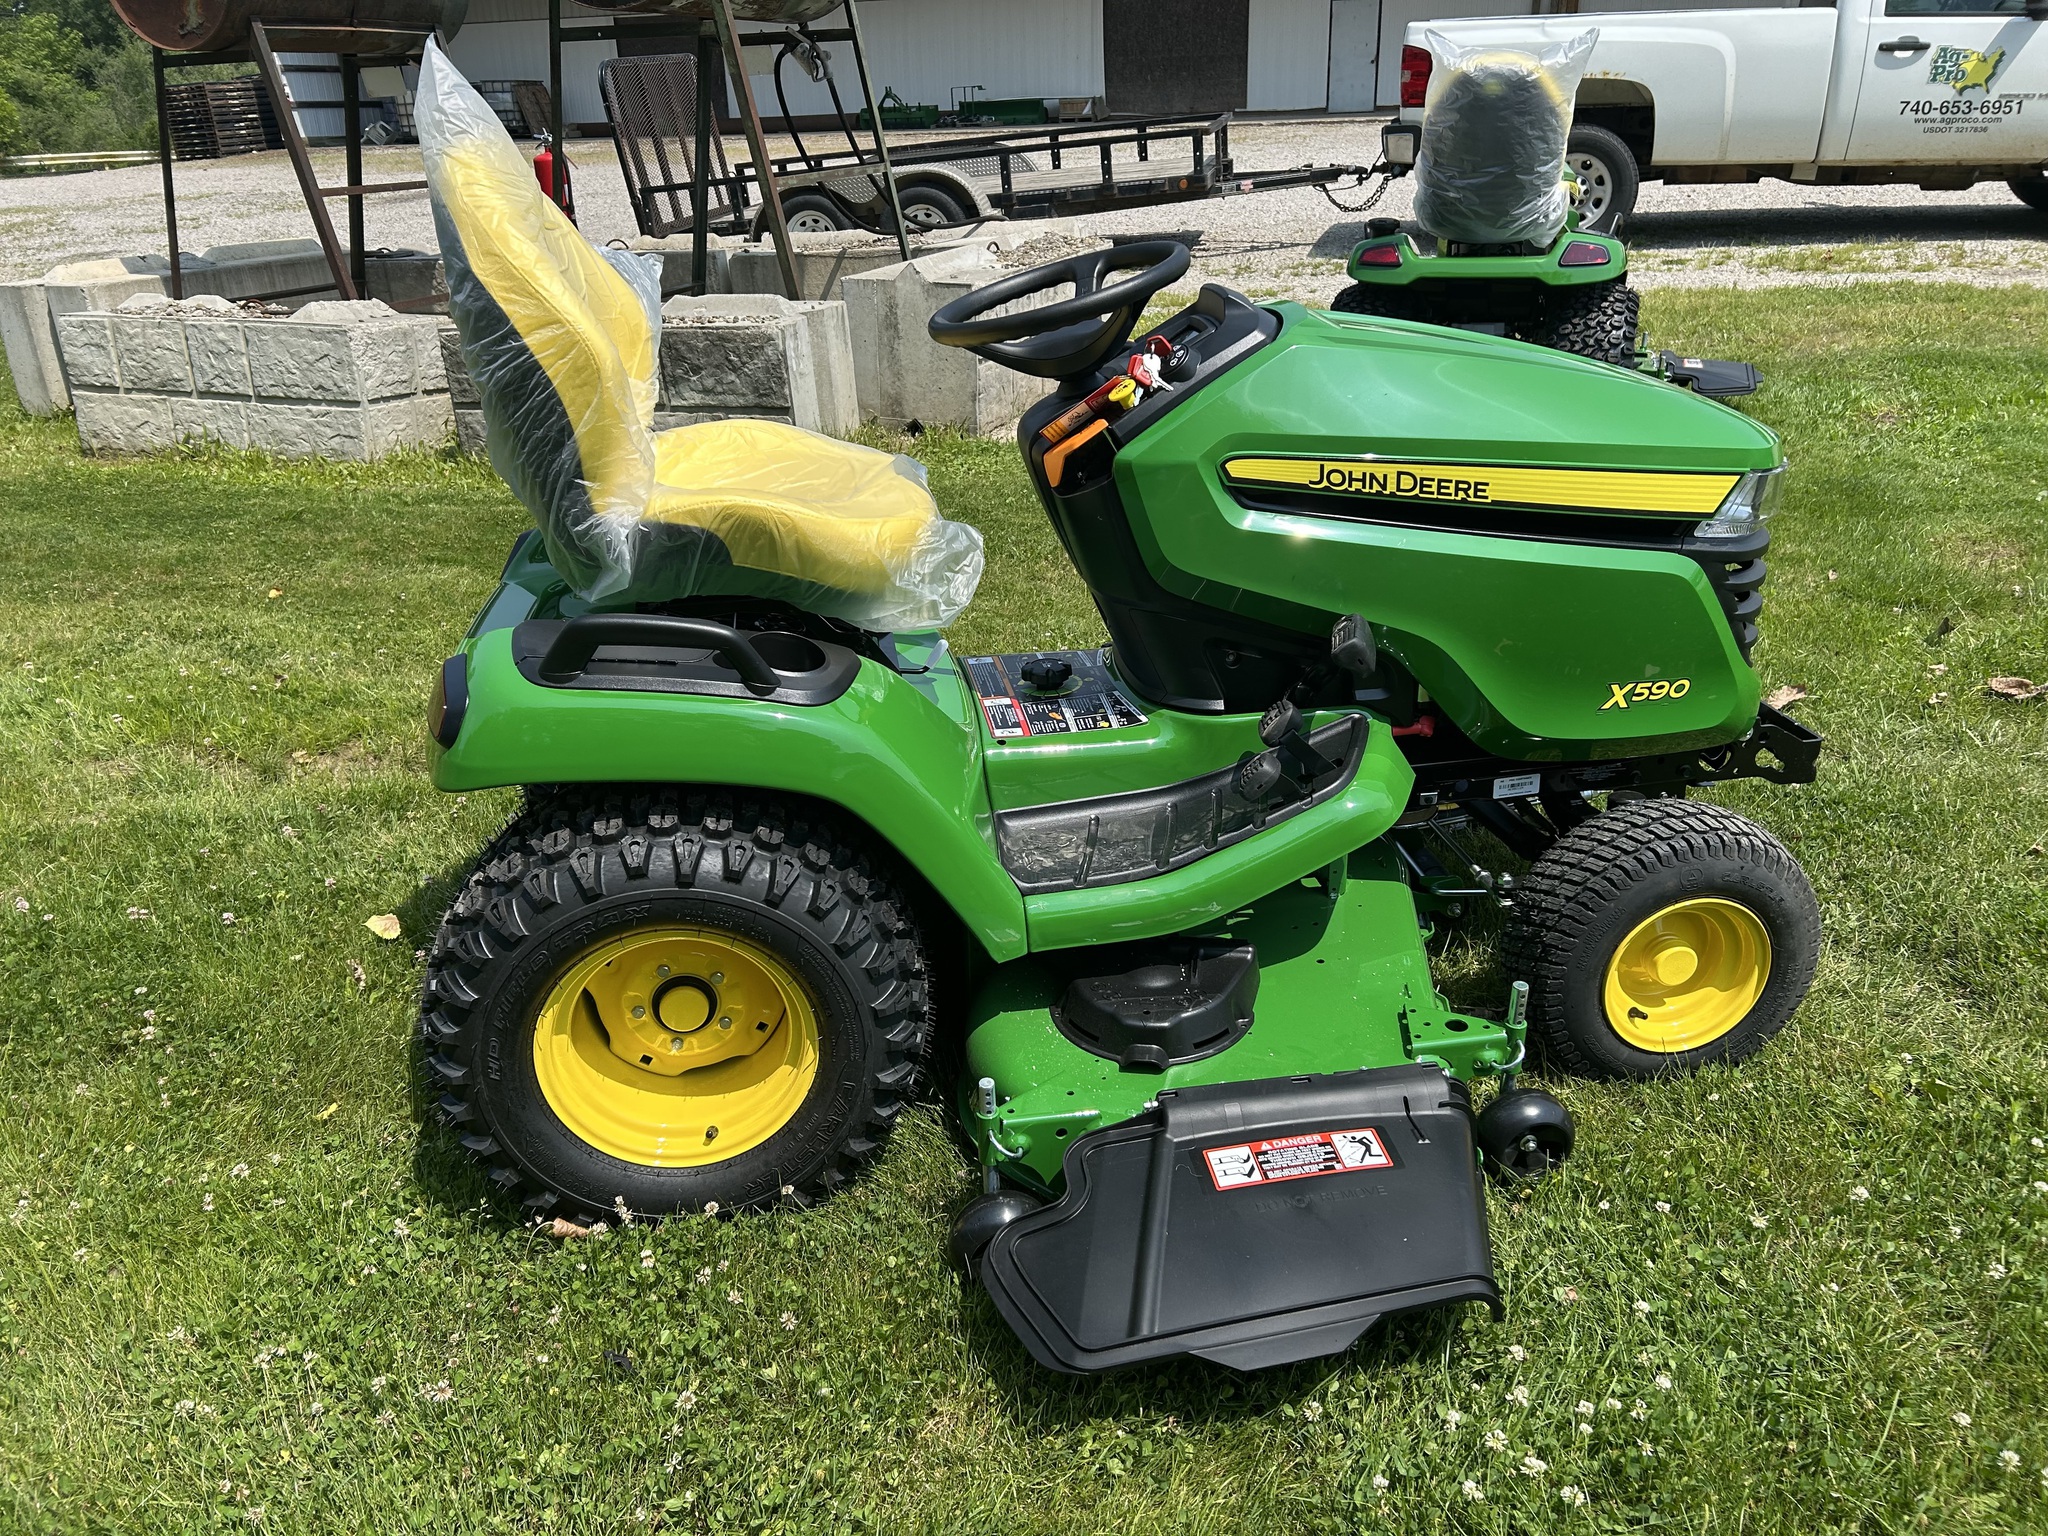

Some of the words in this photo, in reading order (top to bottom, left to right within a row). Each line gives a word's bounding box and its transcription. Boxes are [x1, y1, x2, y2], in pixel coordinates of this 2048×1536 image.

[1932, 45, 1971, 68] Ag-
[1929, 64, 1969, 84] Pro
[1899, 100, 2024, 116] 740-653-6951
[1914, 116, 2003, 126] www.agproco.com
[1922, 126, 1952, 134] USDOT
[1954, 126, 1989, 134] 3217836
[1308, 463, 1389, 493] JOHN
[1395, 470, 1491, 501] DEERE
[1597, 678, 1692, 711] X590
[553, 903, 653, 953] TRAX
[1273, 1135, 1323, 1149] DANGER
[1254, 1198, 1278, 1214] DO
[1320, 1184, 1389, 1202] REMOVE
